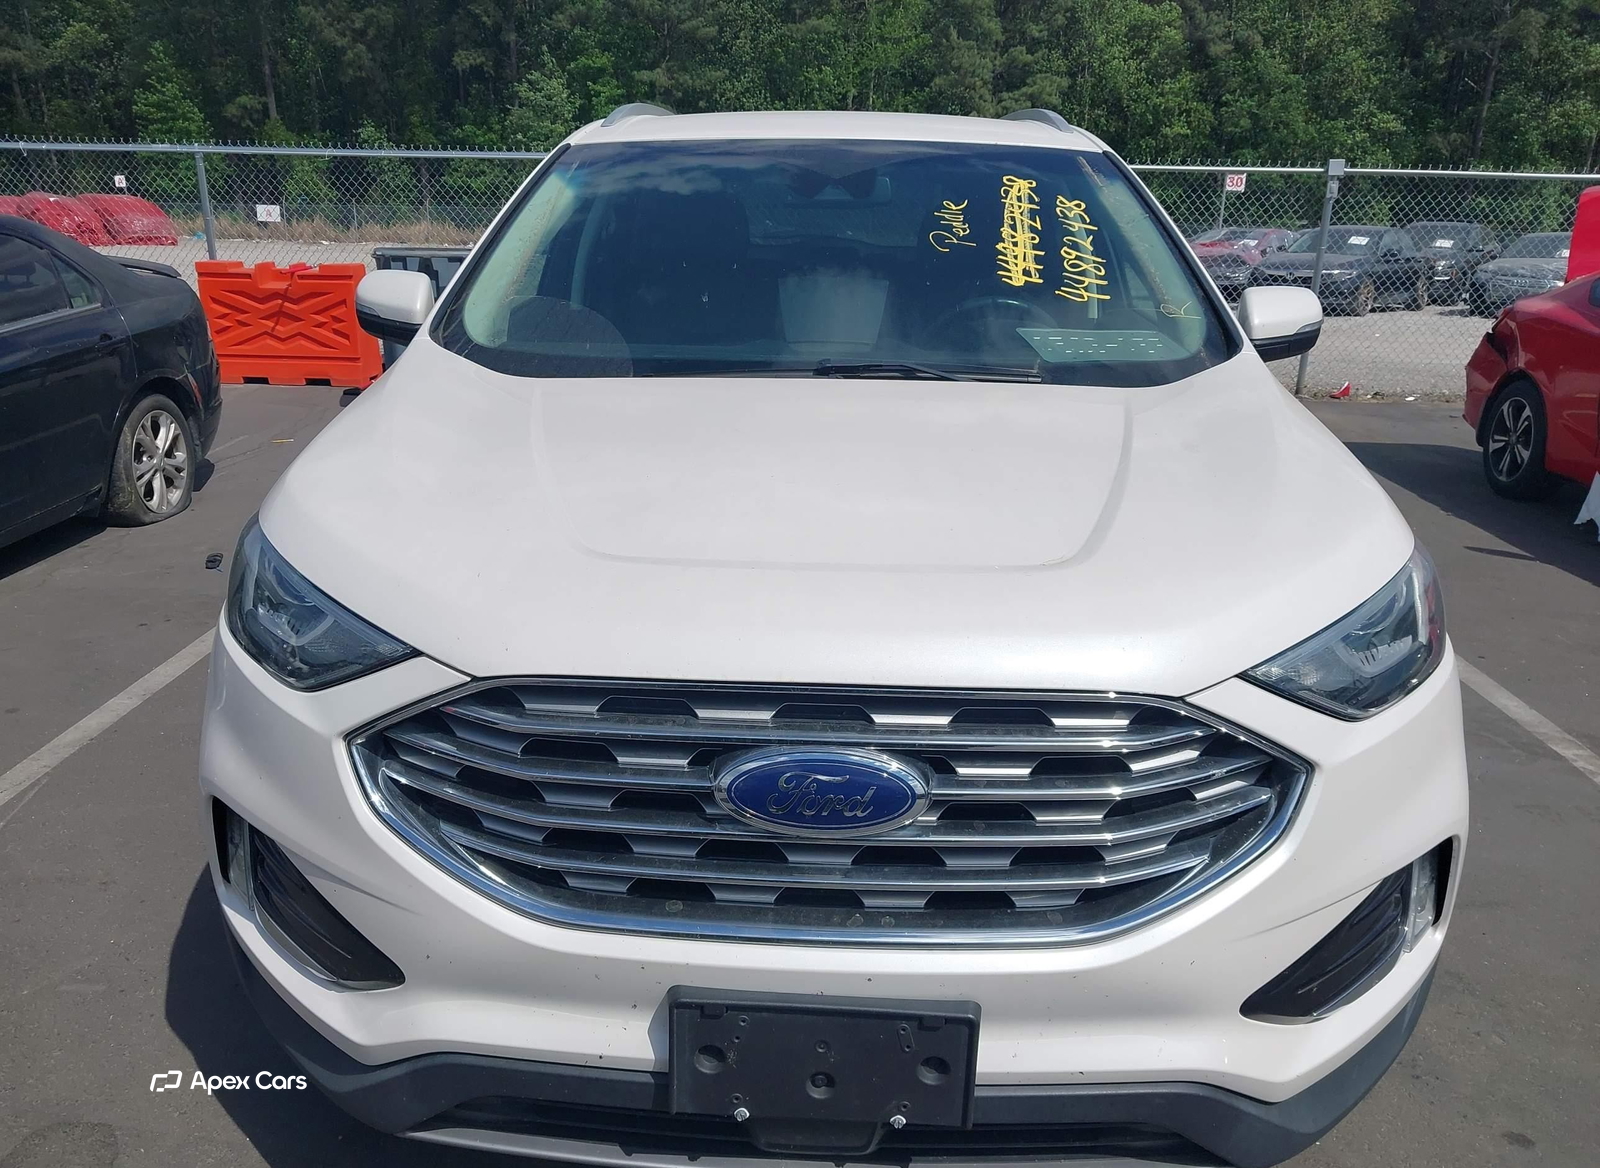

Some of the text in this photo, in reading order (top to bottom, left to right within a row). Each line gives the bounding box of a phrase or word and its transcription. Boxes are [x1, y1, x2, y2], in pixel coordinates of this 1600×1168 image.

[1227, 175, 1243, 188] 30
[1055, 195, 1111, 302] 44892438
[766, 771, 877, 818] Ford
